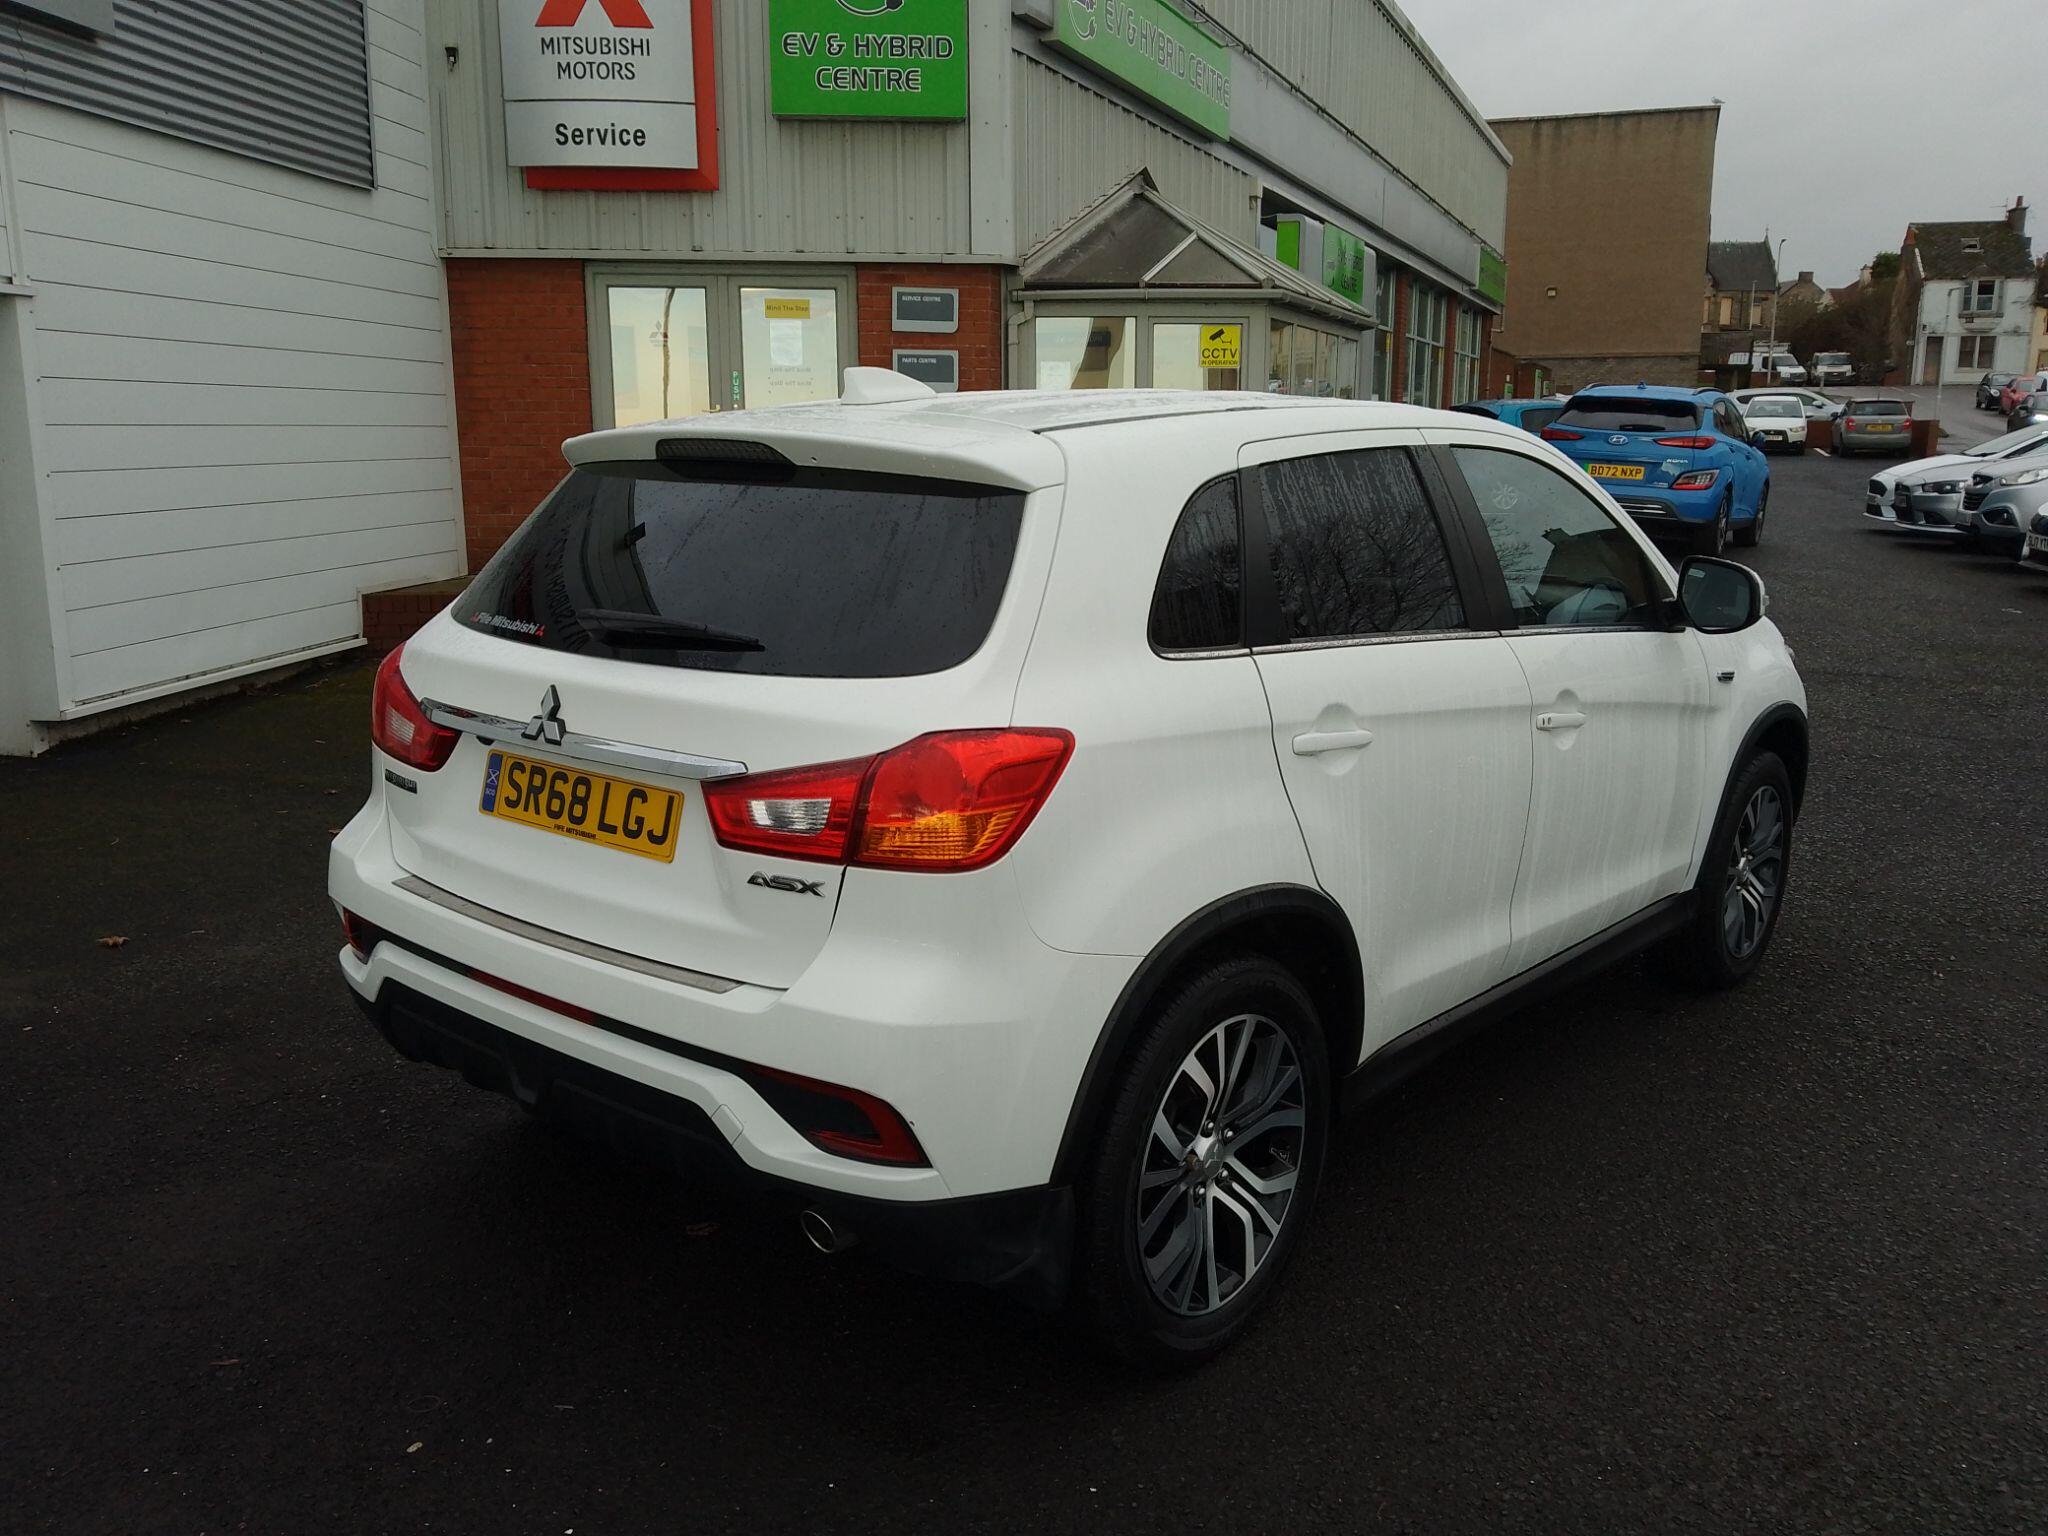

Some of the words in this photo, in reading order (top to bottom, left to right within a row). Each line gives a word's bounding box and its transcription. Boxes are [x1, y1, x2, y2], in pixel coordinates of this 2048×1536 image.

[540, 36, 651, 57] MITSUBISHI
[782, 33, 819, 58] EV
[826, 34, 845, 57] &
[853, 34, 954, 60] HYBRID
[1104, 0, 1125, 38] EV
[1140, 16, 1186, 80] HYBRID
[1188, 52, 1231, 110] CENTRE
[556, 61, 636, 81] MOTORS
[815, 66, 922, 92] CENTRE
[555, 122, 647, 147] Service
[1201, 348, 1238, 359] CCTV
[732, 371, 740, 400] PUSH
[1620, 467, 1643, 478] NXP
[490, 615, 539, 635] Mitsubishi
[504, 761, 592, 826] SR68
[597, 781, 675, 846] LGJ
[565, 826, 597, 841] MITSUBISHI
[747, 870, 826, 898] ASX
